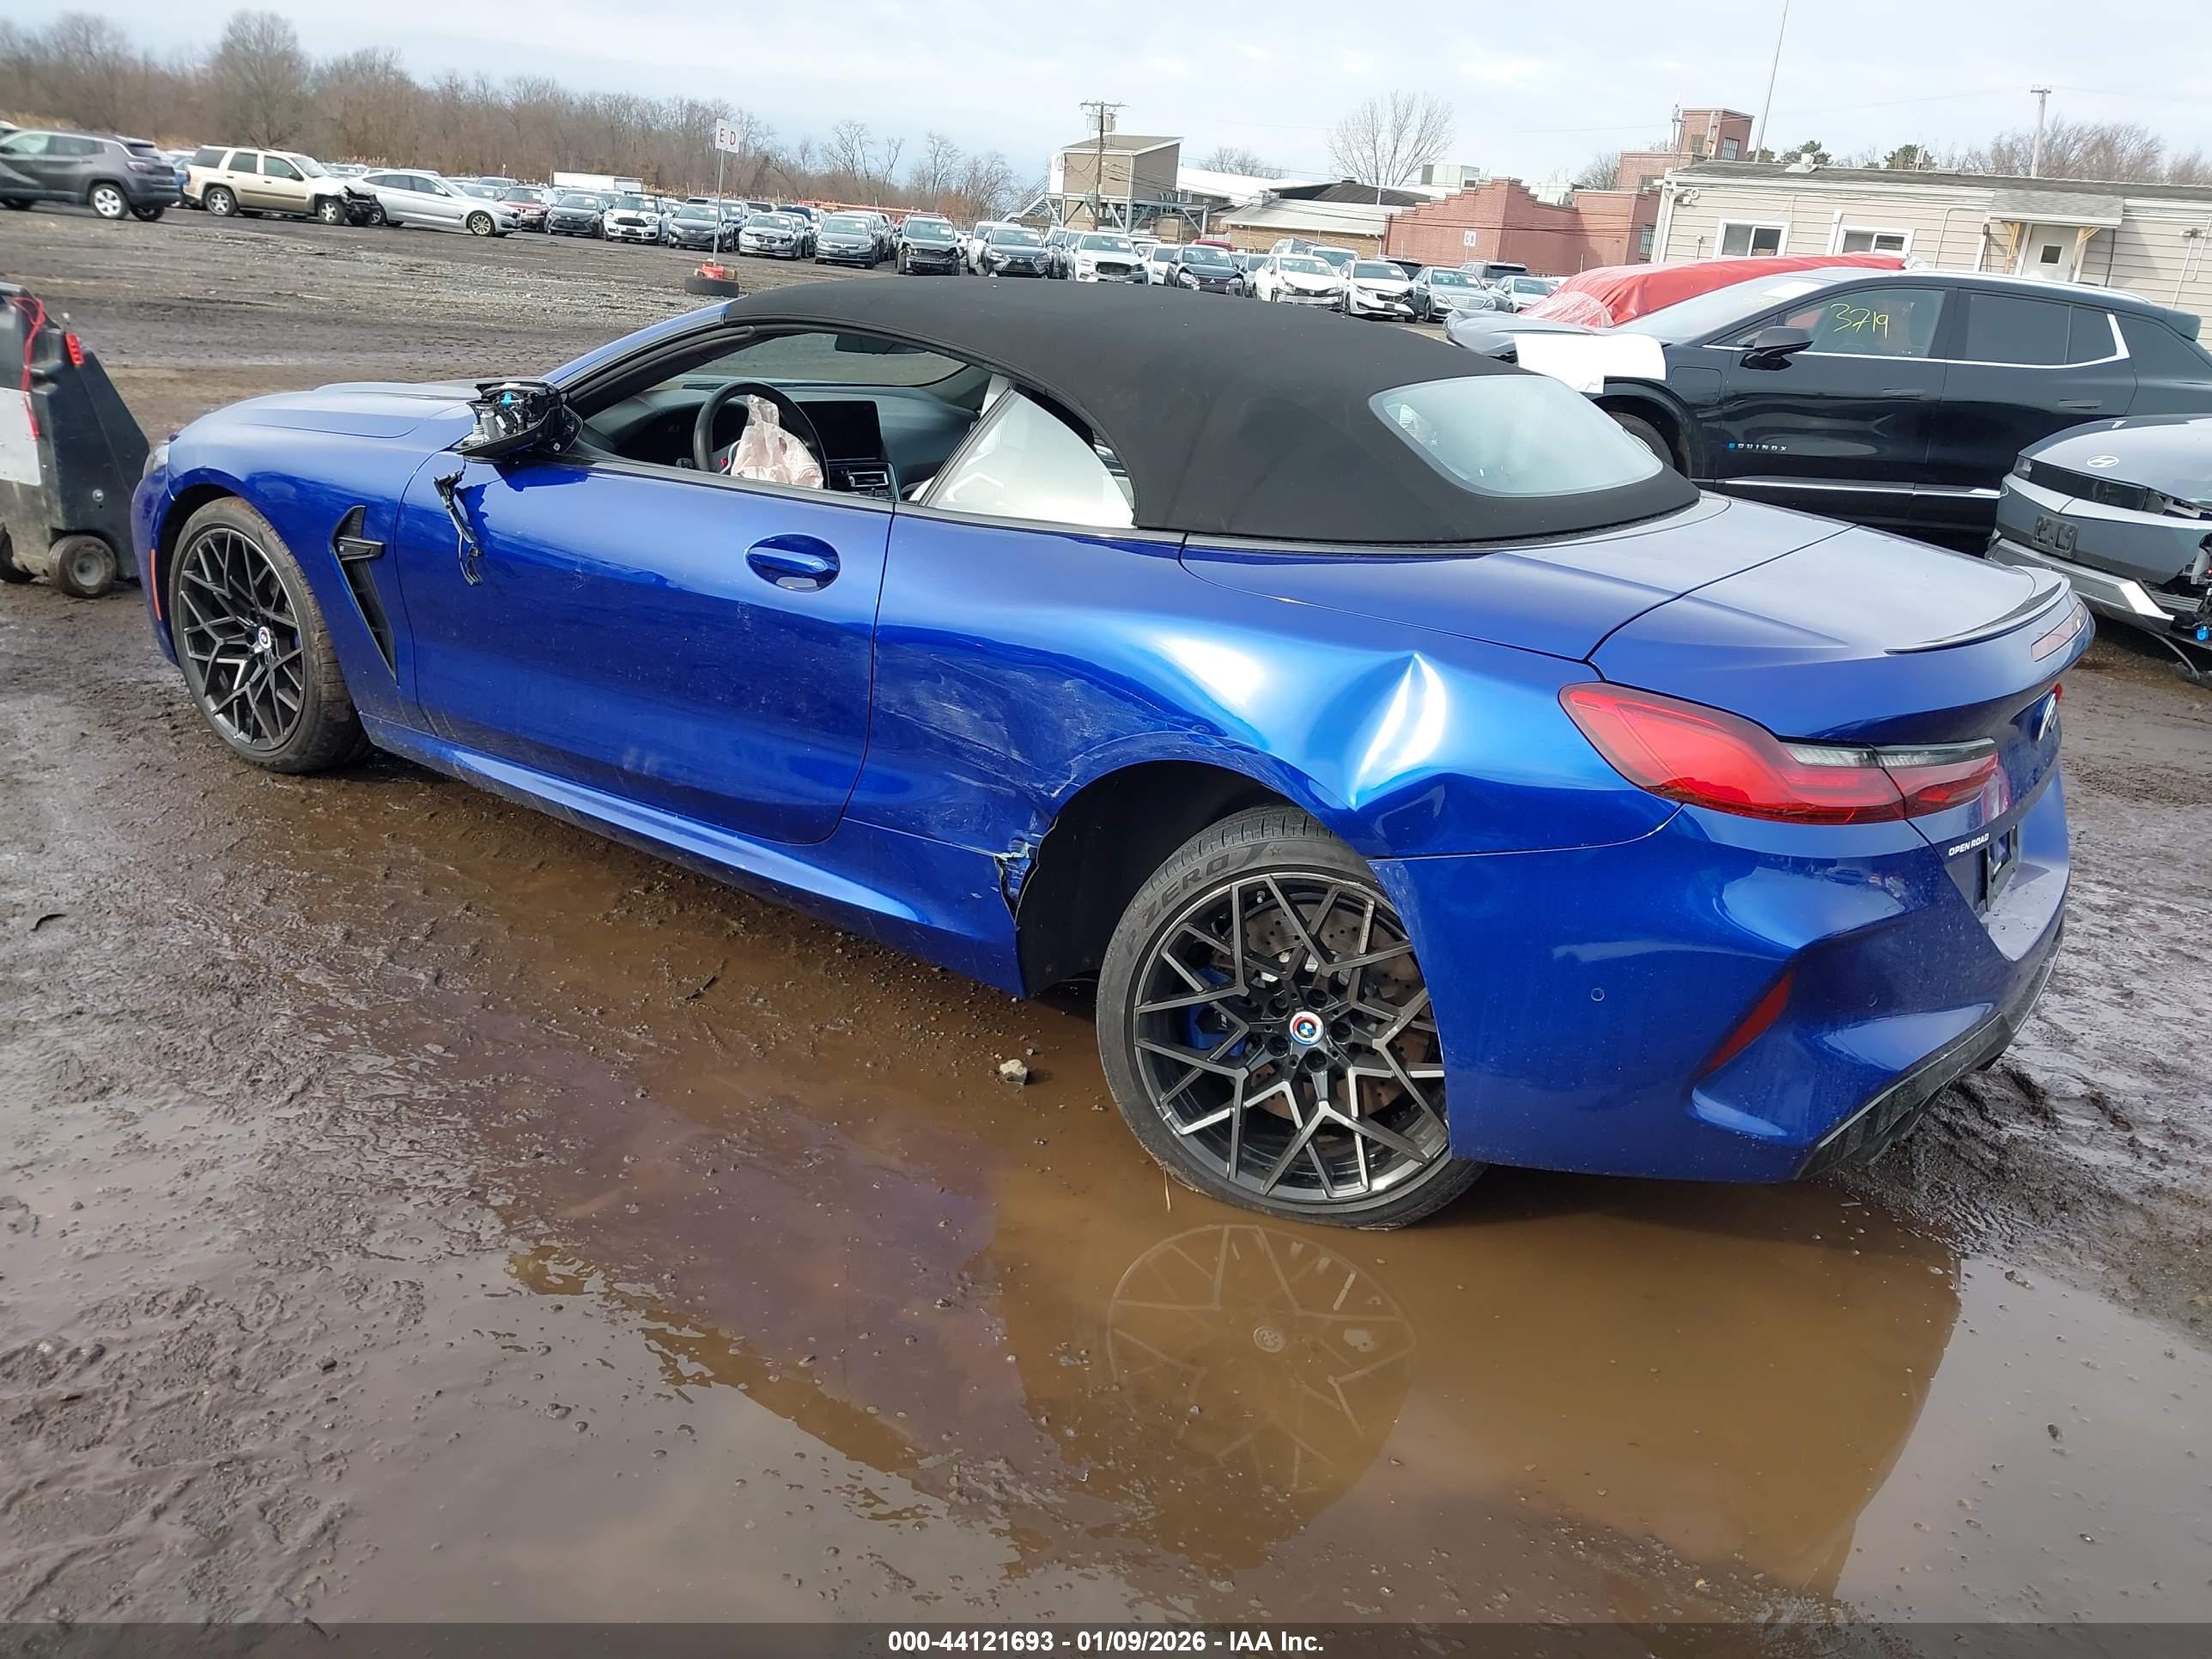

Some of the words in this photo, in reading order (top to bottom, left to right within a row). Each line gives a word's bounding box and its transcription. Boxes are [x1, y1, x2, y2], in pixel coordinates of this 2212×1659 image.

[1830, 303, 1889, 339] 3719
[1948, 841, 1971, 857] OPEN
[1971, 833, 1990, 848] ROAD
[1144, 853, 1231, 928] ZERO
